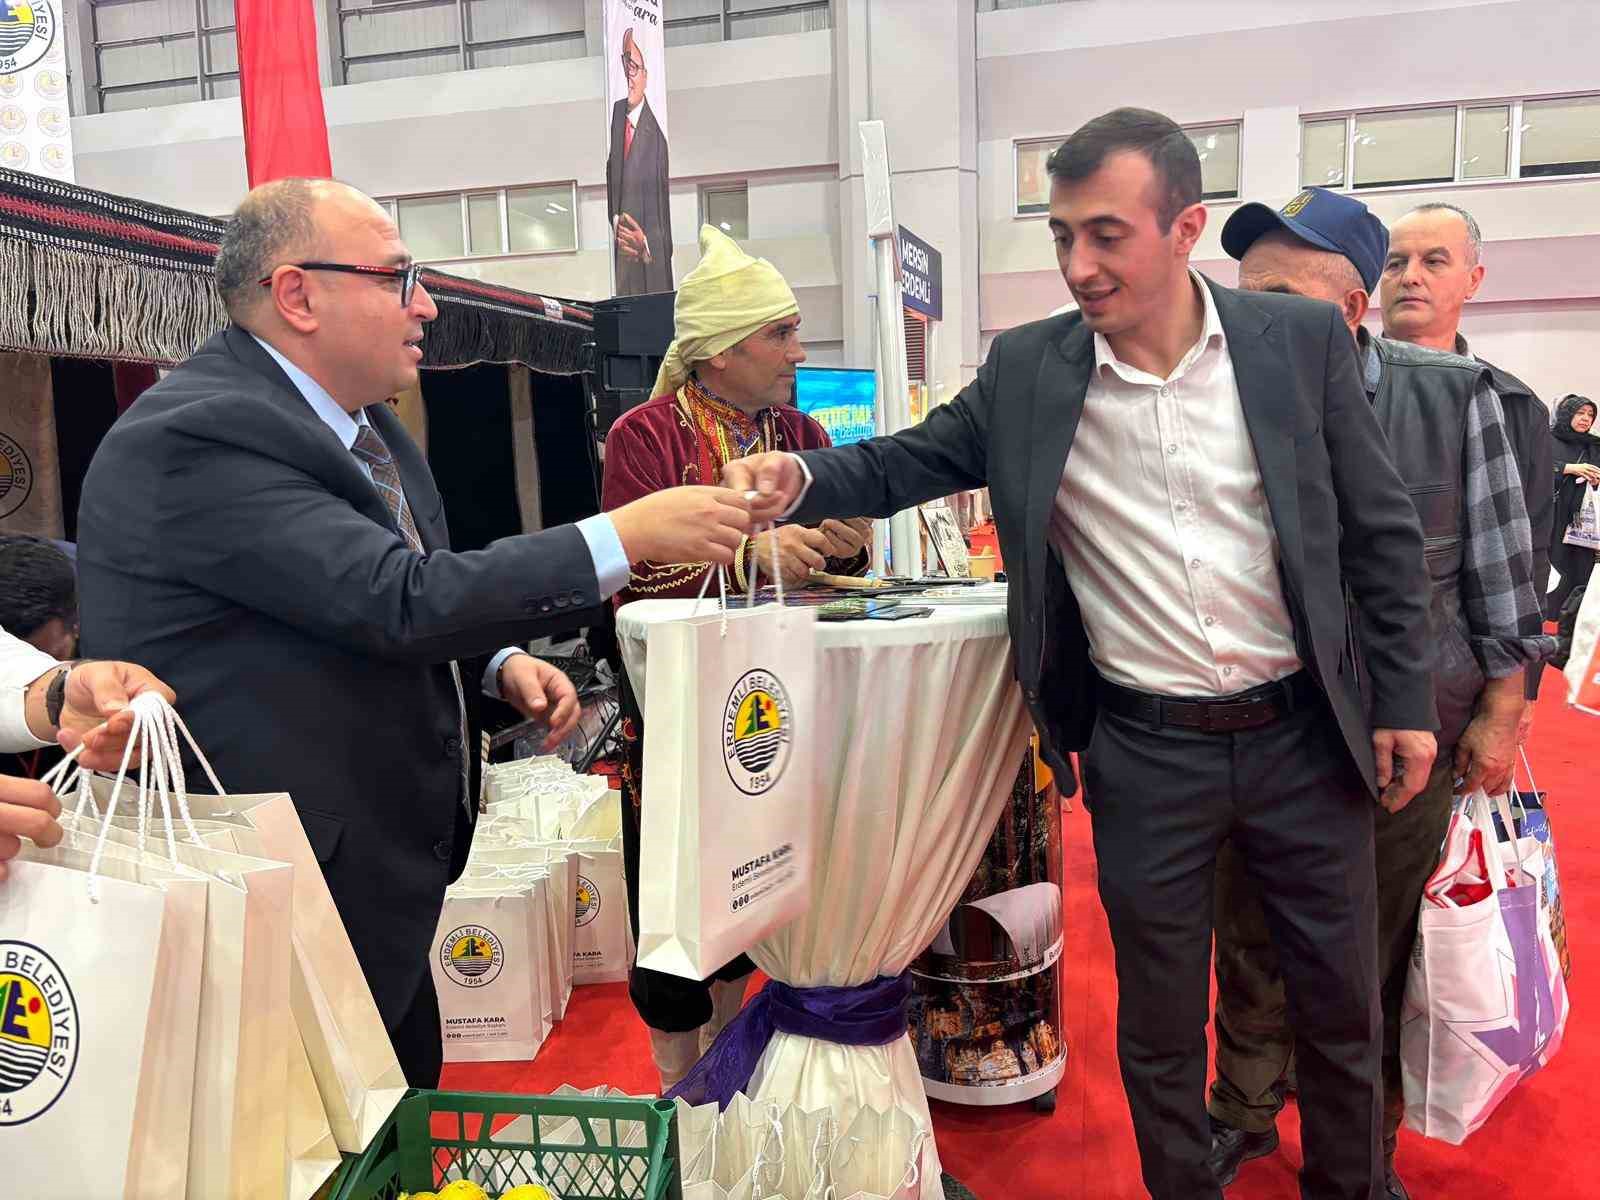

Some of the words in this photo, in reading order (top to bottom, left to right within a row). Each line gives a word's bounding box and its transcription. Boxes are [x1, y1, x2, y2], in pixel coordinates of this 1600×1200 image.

[727, 679, 748, 760] ERDEMLİ
[749, 771, 771, 789] 1954
[731, 853, 771, 881] MUSTAFA
[465, 927, 501, 967] BELEDİYESİ
[463, 976, 482, 985] 1954
[5, 950, 71, 1079] BELEDİYESİ
[445, 1017, 483, 1025] MUSTAFA
[484, 1016, 506, 1024] KARA
